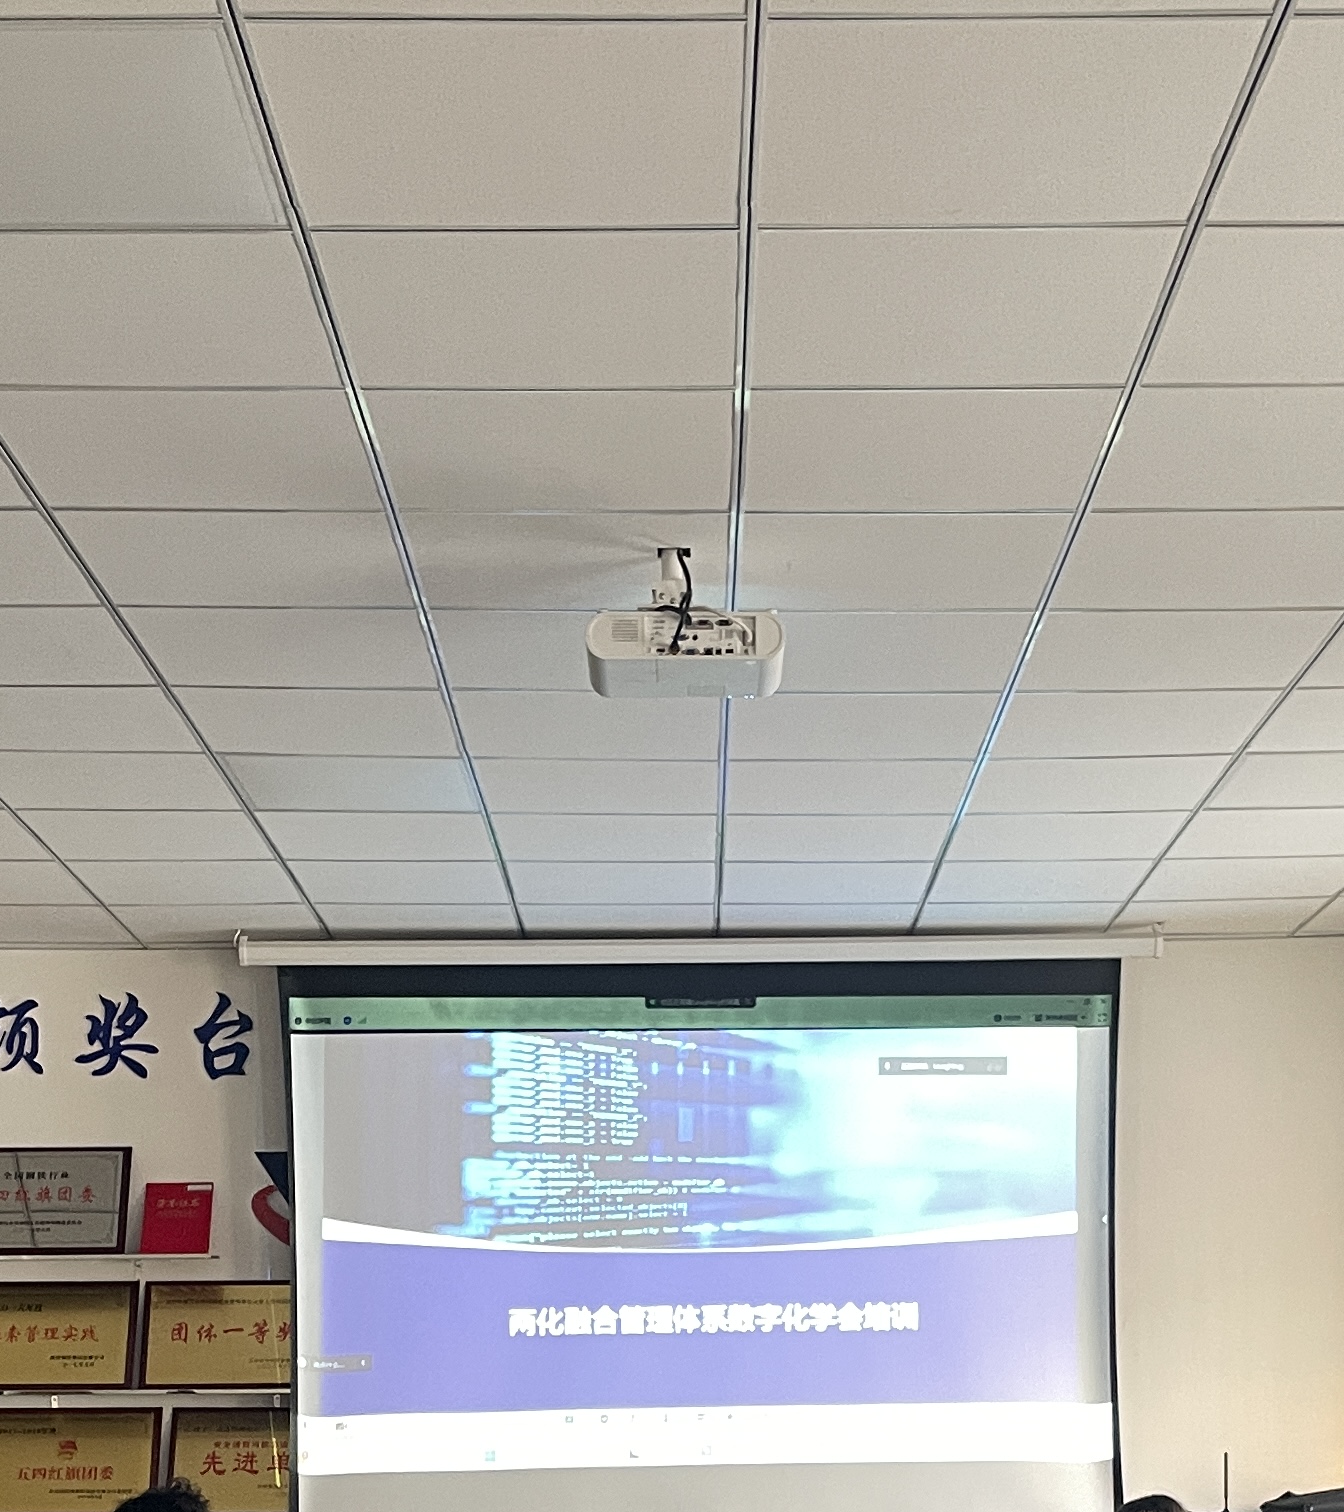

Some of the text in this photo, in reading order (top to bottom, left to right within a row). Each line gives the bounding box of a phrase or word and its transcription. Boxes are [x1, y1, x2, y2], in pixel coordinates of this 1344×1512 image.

[16, 1464, 114, 1482] 五四红旗团委
